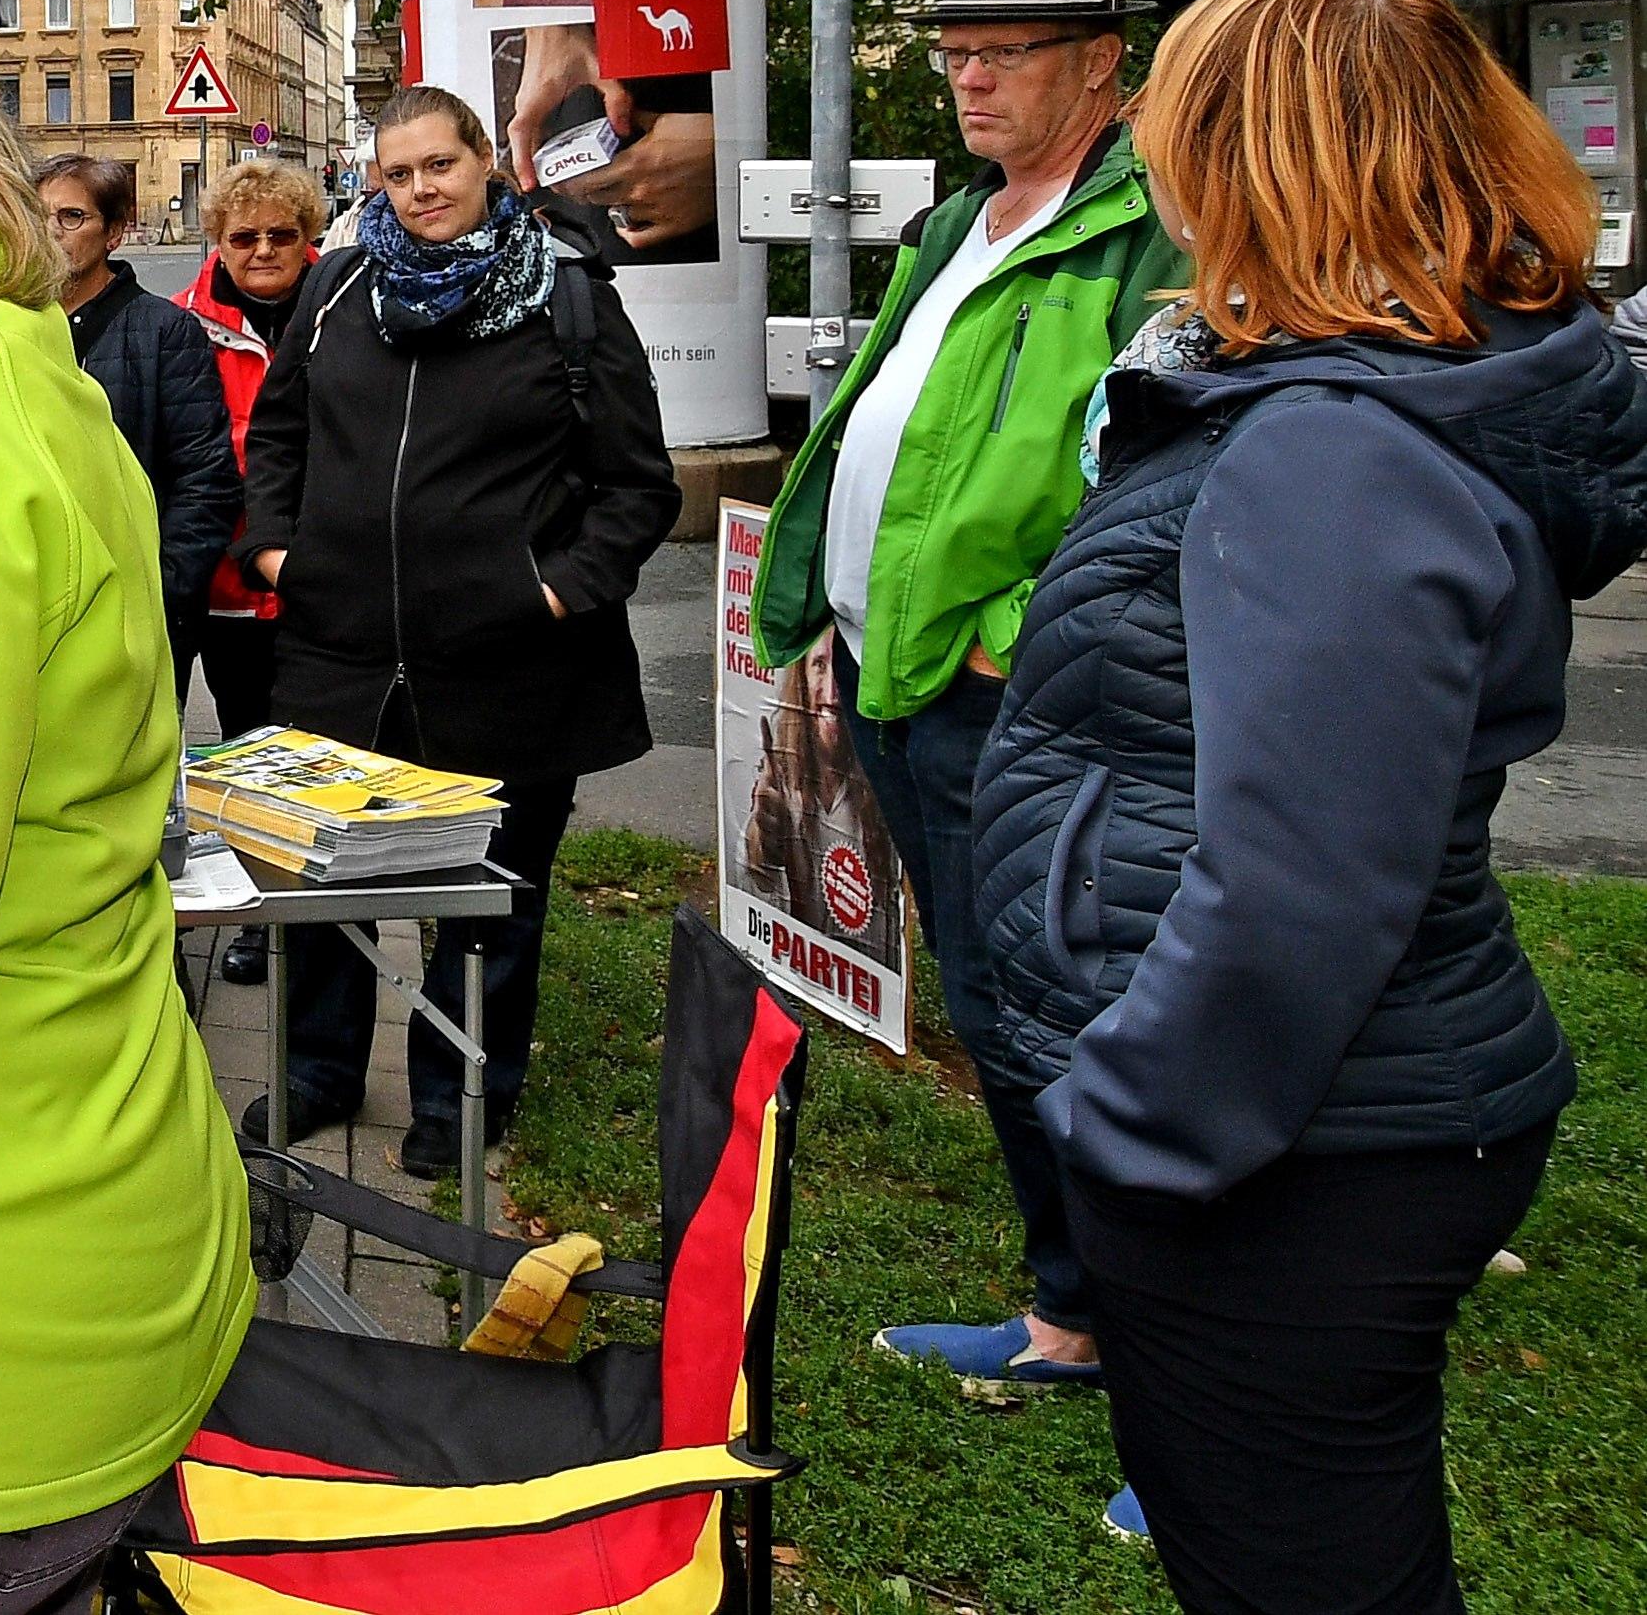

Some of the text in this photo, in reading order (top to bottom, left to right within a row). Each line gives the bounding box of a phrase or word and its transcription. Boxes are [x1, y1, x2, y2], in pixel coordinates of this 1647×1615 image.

[544, 152, 598, 177] CAMEL
[686, 345, 716, 361] sein
[729, 521, 764, 559] Mac
[727, 564, 753, 596] mit
[726, 602, 750, 637] dei
[748, 906, 881, 1022] Die PARTEI
